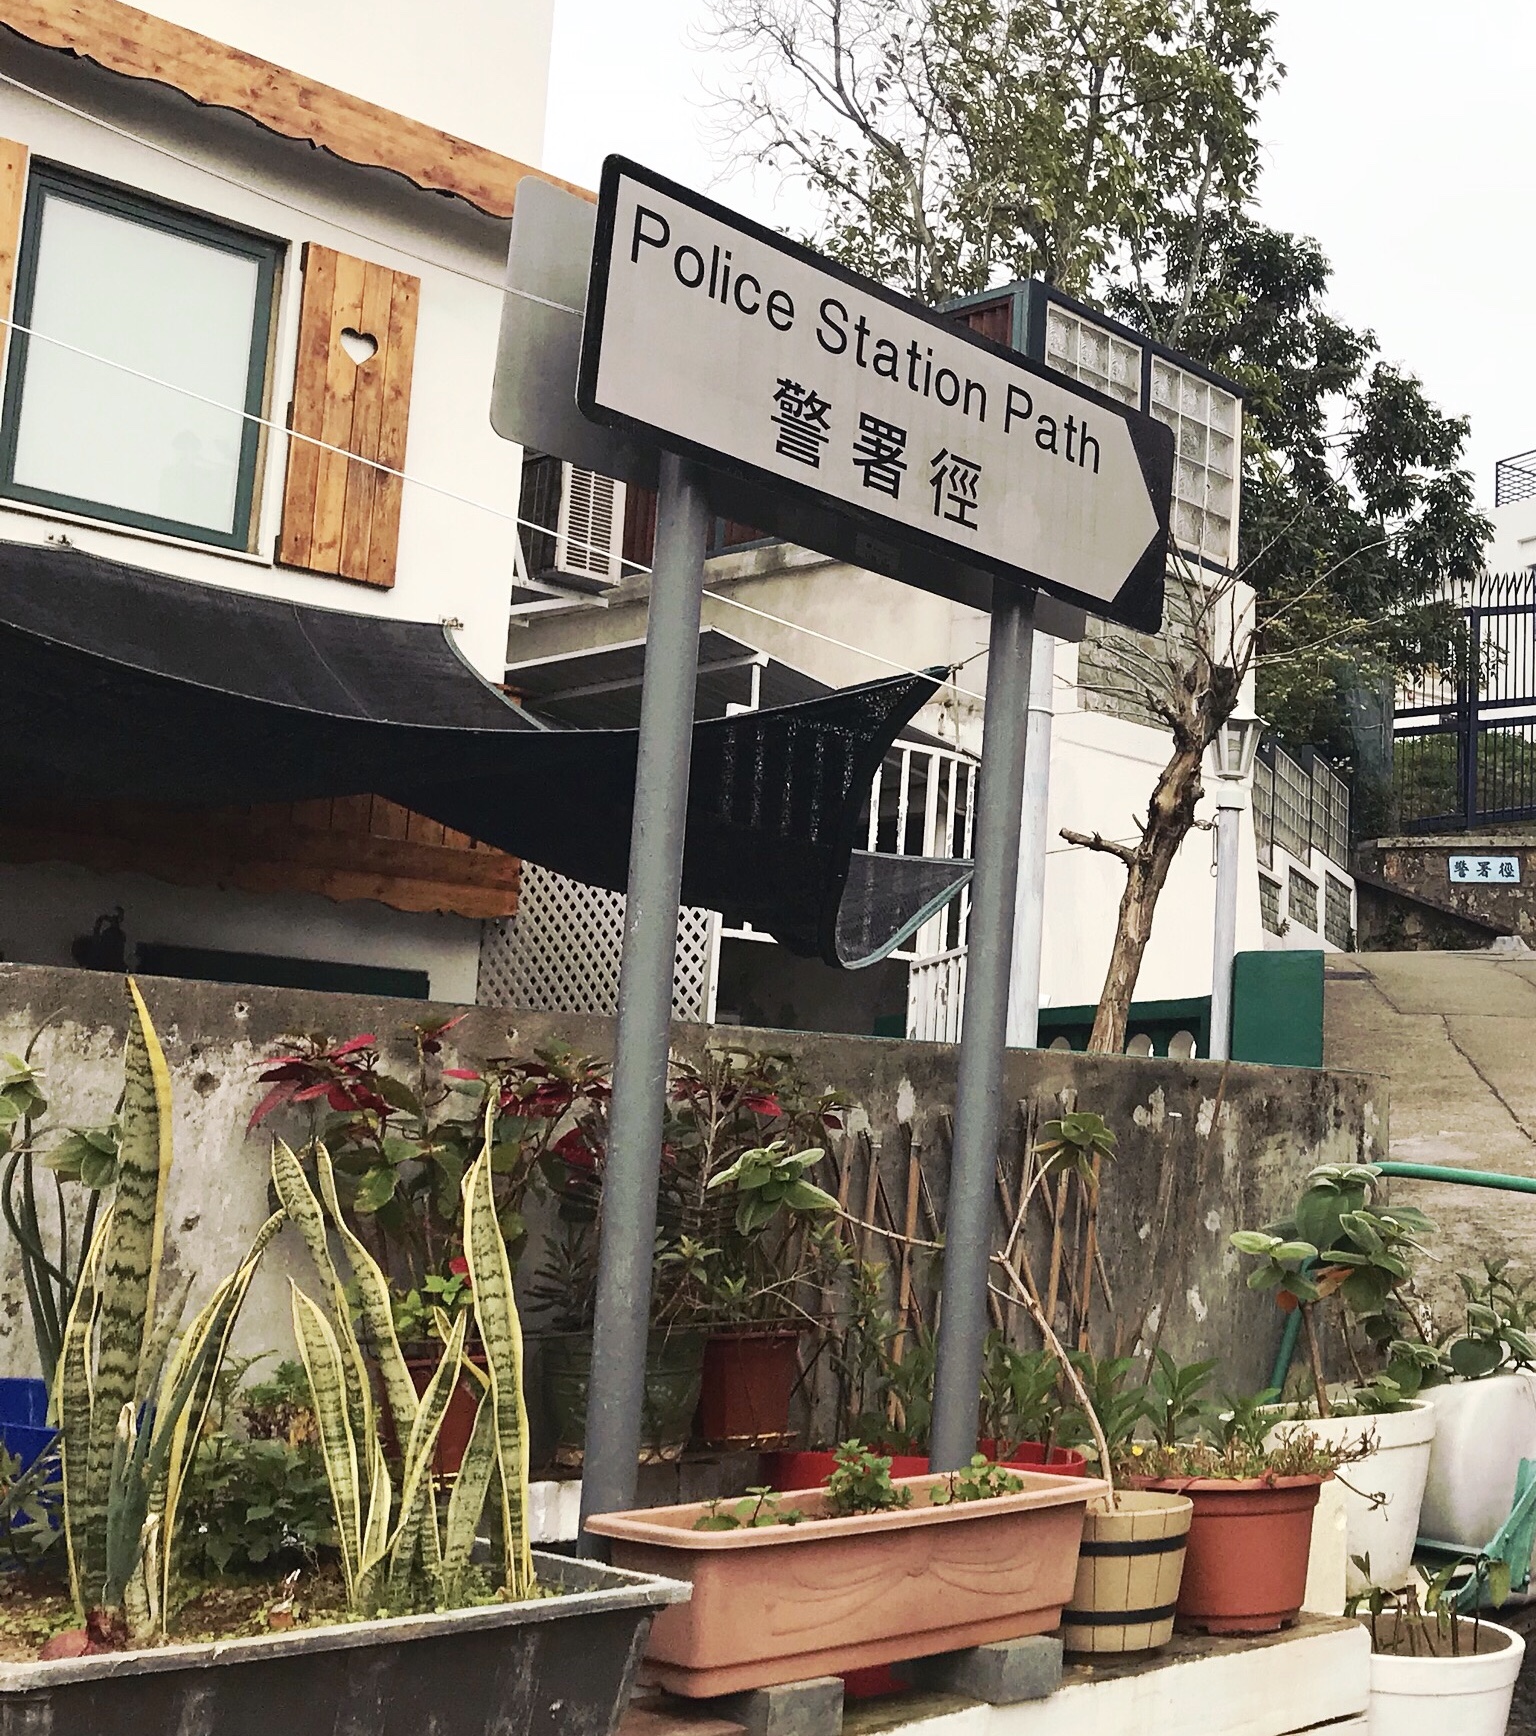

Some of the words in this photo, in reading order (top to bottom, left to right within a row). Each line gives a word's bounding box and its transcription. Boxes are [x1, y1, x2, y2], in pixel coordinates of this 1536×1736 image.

[631, 204, 794, 331] Police
[816, 298, 986, 422] Station
[1004, 384, 1101, 474] Path
[770, 378, 982, 531] 警署徑
[1453, 859, 1515, 878] 警署徑
